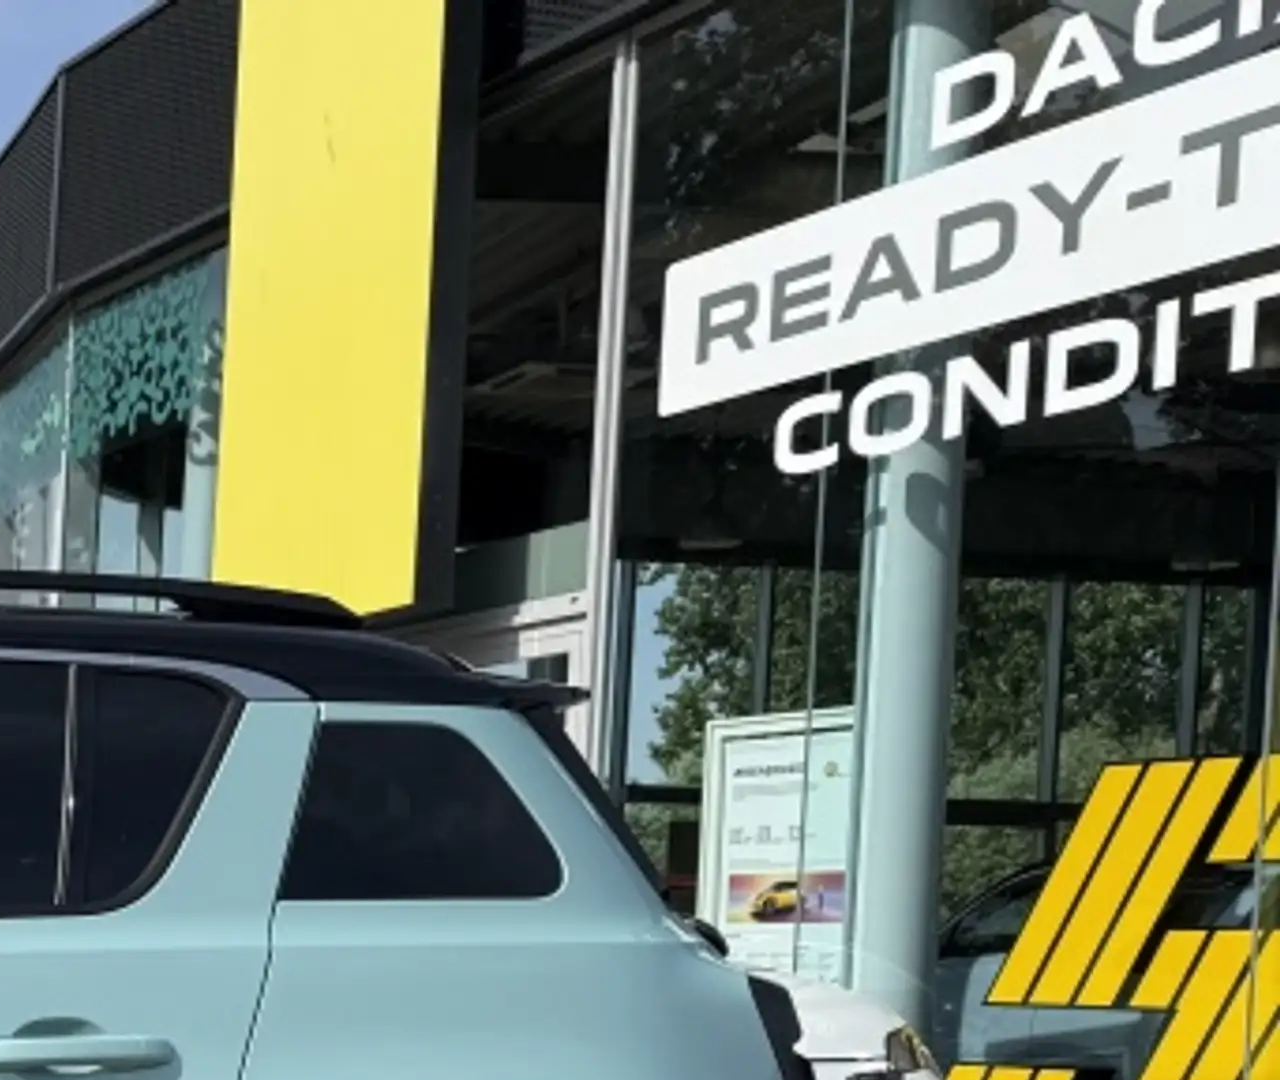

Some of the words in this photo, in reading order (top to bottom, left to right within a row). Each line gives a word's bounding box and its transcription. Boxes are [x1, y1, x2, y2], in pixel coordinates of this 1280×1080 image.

[929, 0, 1280, 150] DAC
[694, 104, 1280, 365] READY-T
[773, 270, 1280, 475] CONDIT
